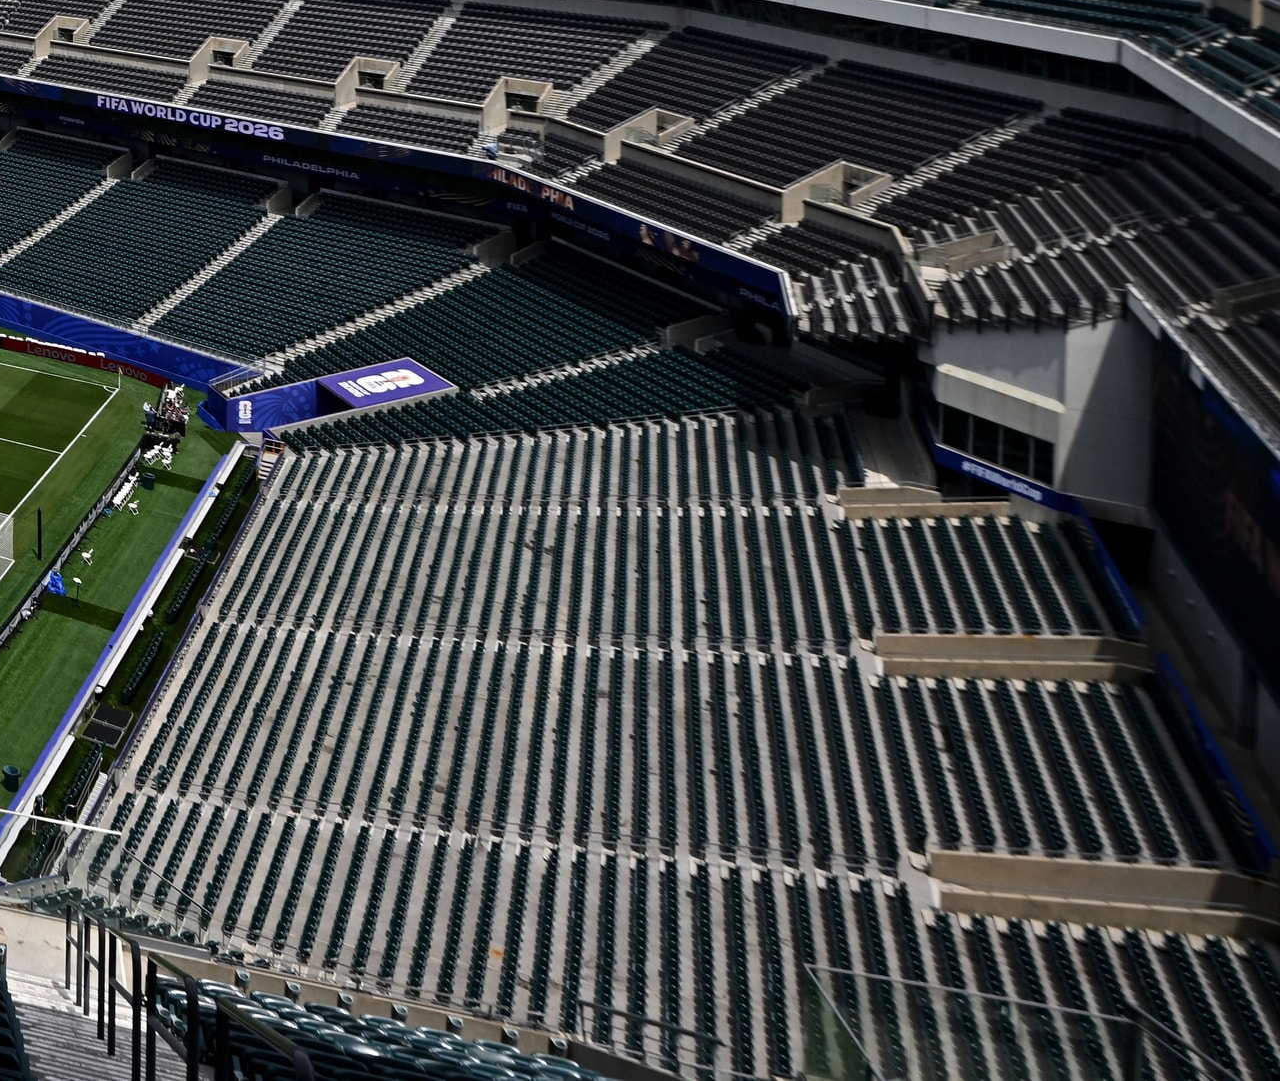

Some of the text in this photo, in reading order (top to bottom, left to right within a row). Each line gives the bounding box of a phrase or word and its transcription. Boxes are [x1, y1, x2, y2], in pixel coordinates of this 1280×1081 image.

[97, 95, 284, 140] FIFA WORLD CUP 2026
[263, 155, 359, 180] PHILADELPHIA
[490, 168, 574, 210] HILADPHIA
[27, 343, 76, 363] Lenovo
[100, 359, 147, 381] Lenovo
